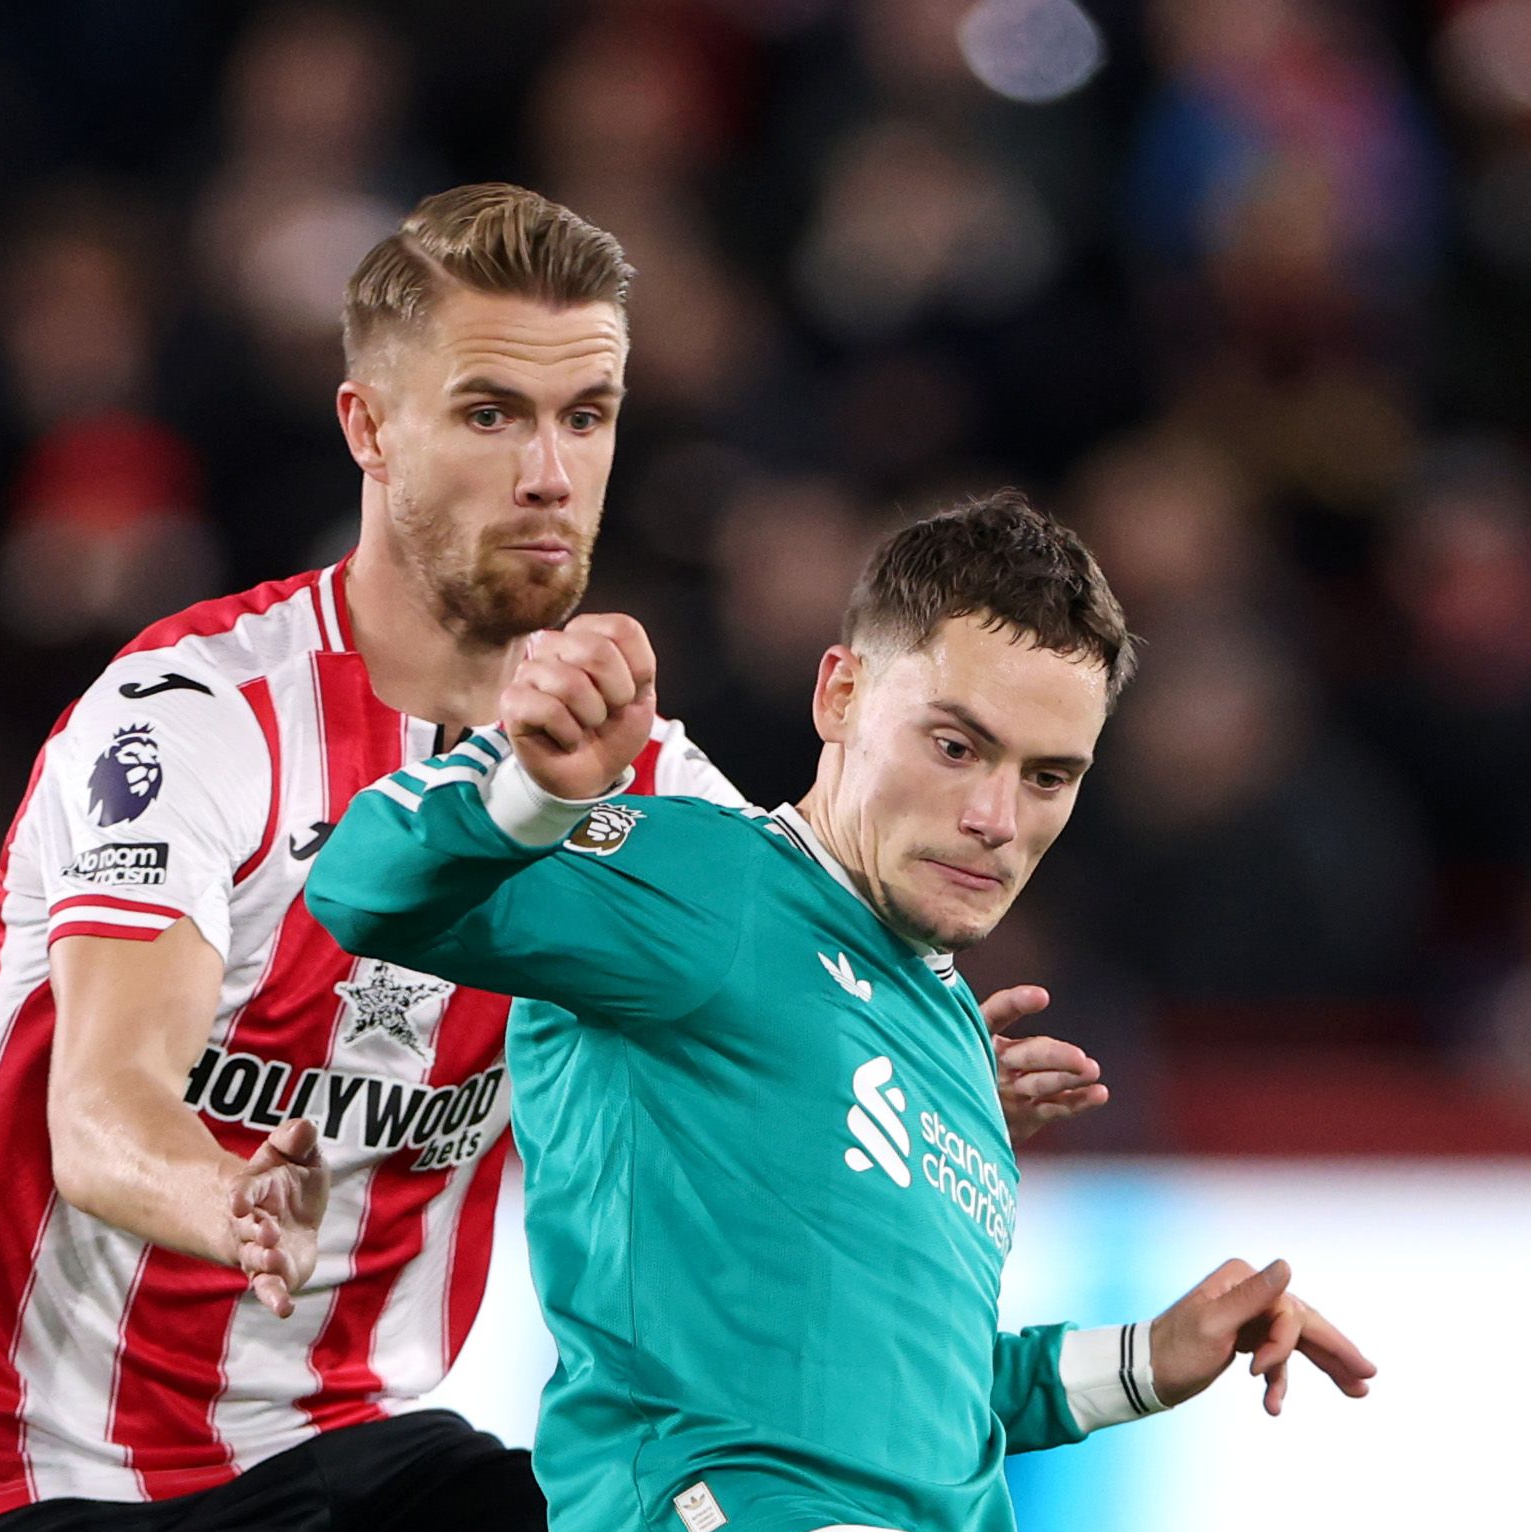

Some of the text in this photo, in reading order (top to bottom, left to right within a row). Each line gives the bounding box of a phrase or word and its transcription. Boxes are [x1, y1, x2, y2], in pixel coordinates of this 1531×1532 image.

[70, 847, 158, 873] No room
[182, 1047, 504, 1148] HOLLYWOOD
[418, 1131, 481, 1168] bets
